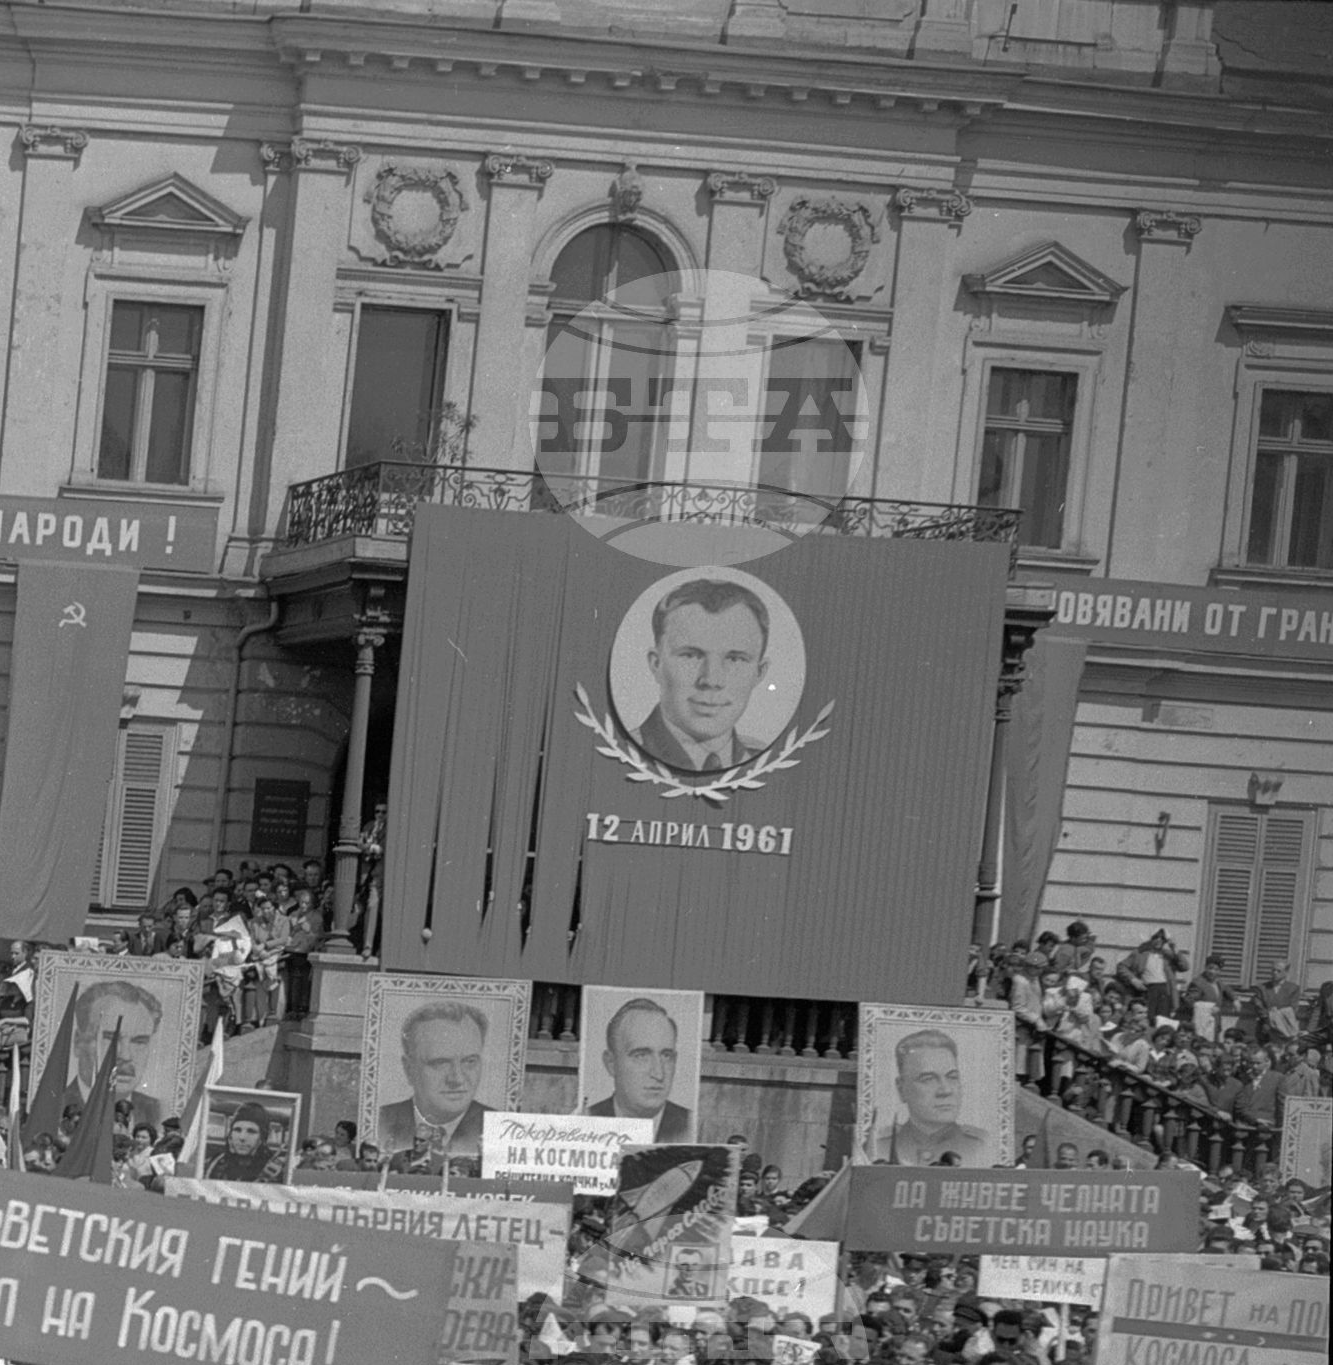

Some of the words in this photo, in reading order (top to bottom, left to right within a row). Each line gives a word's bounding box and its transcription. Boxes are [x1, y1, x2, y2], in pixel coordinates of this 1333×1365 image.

[1051, 591, 1191, 634] ОВЯВАНИ
[1204, 603, 1247, 637] ОТ
[587, 813, 620, 842] 12
[630, 820, 710, 848] АПРИЛ
[721, 823, 794, 855] 1961
[508, 1146, 527, 1165] НА
[535, 1147, 621, 1170] КОСМОСА
[892, 1180, 926, 1208] ДА
[938, 1180, 1028, 1212] ЖИВЕЕ
[1039, 1182, 1160, 1214] ЧЕЛНАТА
[332, 1204, 444, 1238] ПЪРВИЯ
[914, 1215, 1052, 1245] СЪВЕТСКА
[1063, 1217, 1150, 1248] НАУКА
[1021, 1278, 1083, 1297] ВЕЛИКА
[1126, 1278, 1235, 1327] ПРИВЕТ
[1249, 1304, 1279, 1325] НА
[41, 1286, 95, 1340] НА
